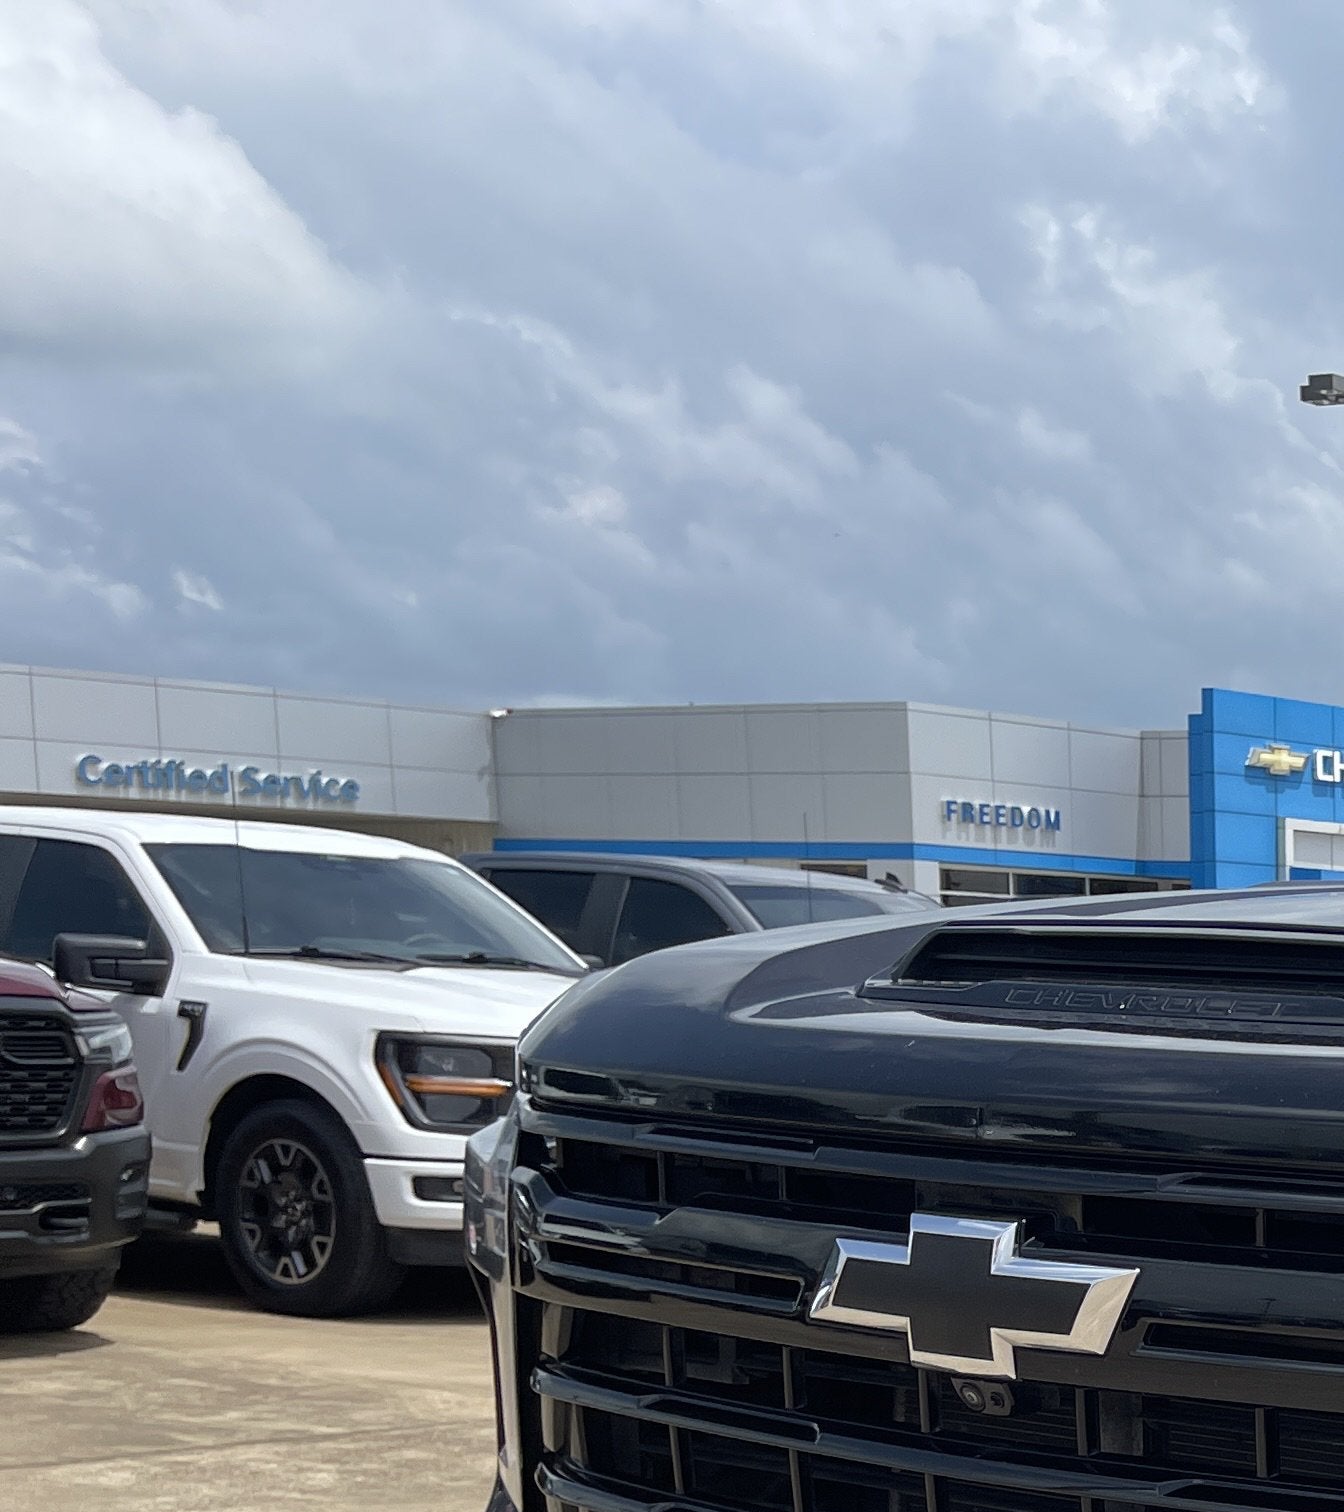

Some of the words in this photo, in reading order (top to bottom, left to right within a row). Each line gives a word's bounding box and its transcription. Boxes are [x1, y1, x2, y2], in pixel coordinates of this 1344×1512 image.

[77, 754, 229, 795] Certified
[237, 765, 361, 801] Service
[945, 799, 1061, 831] FREEDOM
[1002, 986, 1301, 1019] CHEVROLET
